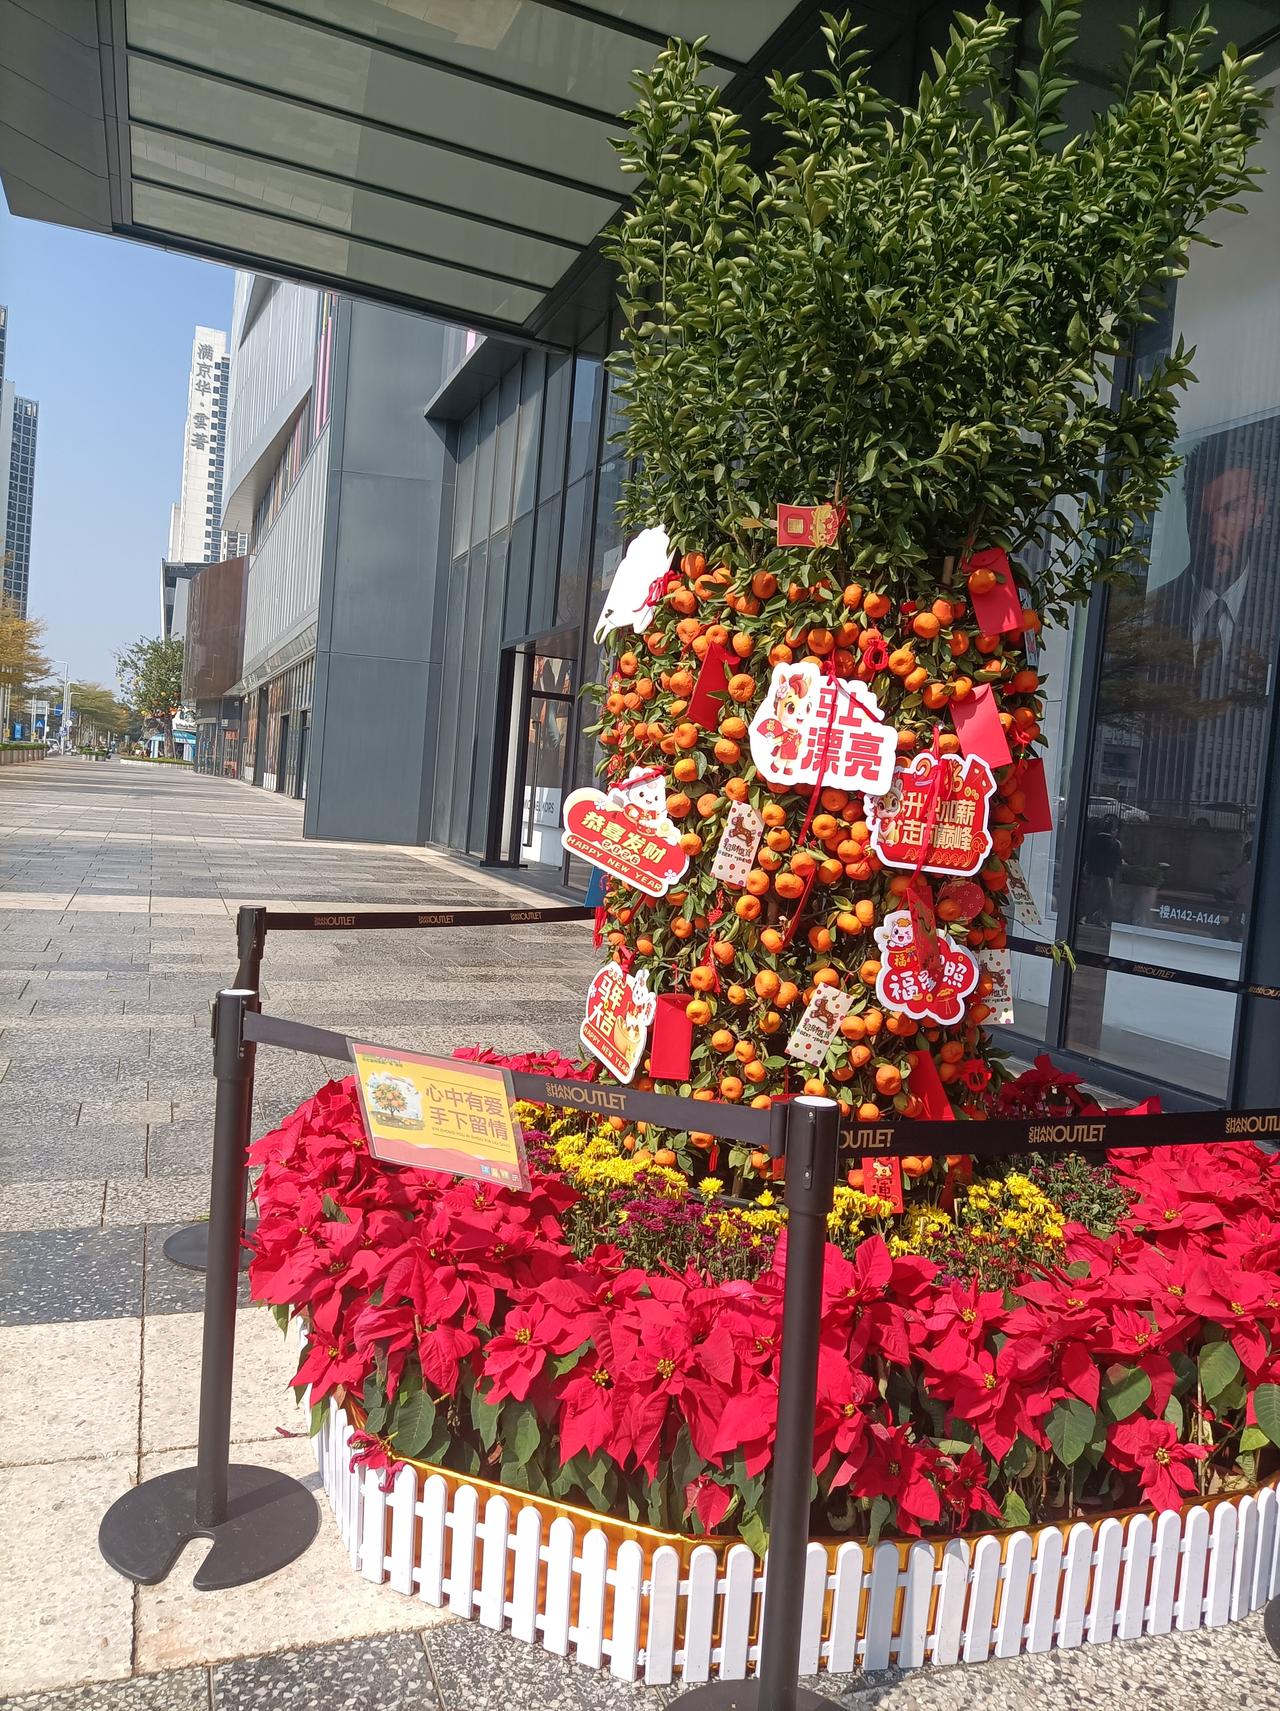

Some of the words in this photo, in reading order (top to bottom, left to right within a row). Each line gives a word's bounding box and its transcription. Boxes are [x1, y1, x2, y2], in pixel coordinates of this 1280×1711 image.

[800, 727, 884, 781] 漂亮
[901, 792, 976, 826] 升加薪
[581, 811, 667, 864] 恭喜发财
[602, 839, 641, 865] 2026
[567, 837, 603, 858] HAPPY
[607, 858, 630, 873] NEW
[635, 872, 661, 891] YEAR
[598, 975, 624, 1010] 马年
[589, 1002, 616, 1037] 大吉
[426, 1083, 506, 1118] 心中有爱
[571, 1087, 626, 1110] OUTLET
[430, 1106, 509, 1141] 手下留情
[1053, 1125, 1106, 1142] OUTLET
